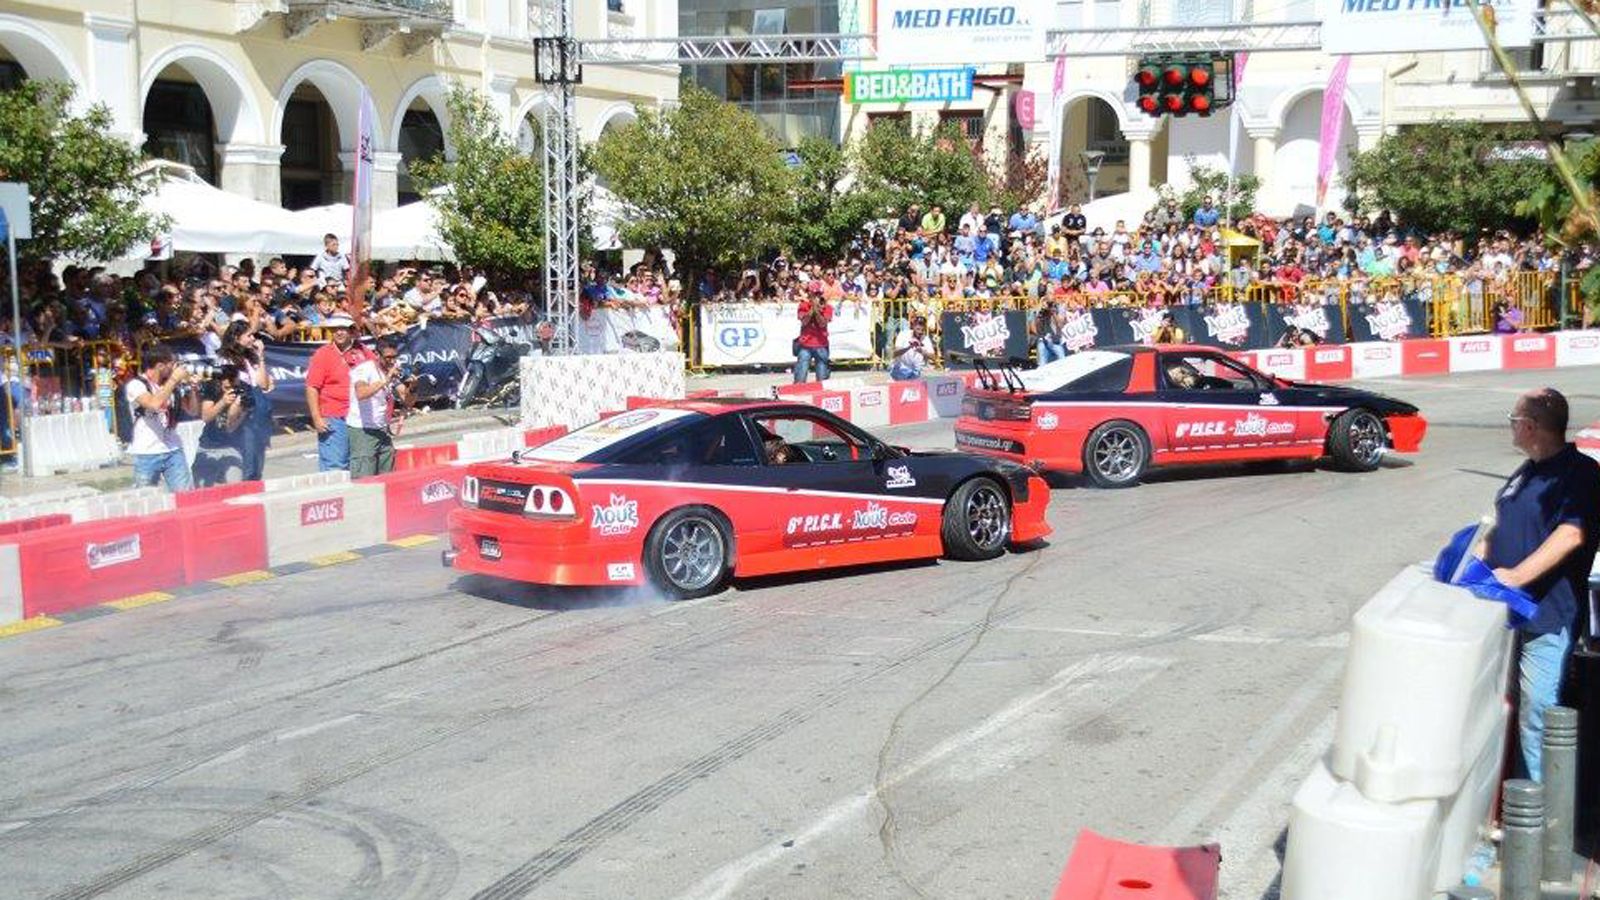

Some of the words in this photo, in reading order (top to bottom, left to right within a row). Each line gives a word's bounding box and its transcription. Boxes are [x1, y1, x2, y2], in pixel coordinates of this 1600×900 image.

[893, 10, 940, 28] MED
[946, 6, 1015, 27] FRIGO
[855, 71, 967, 100] BED&BATH
[720, 327, 759, 347] GP
[306, 501, 339, 523] AVIS
